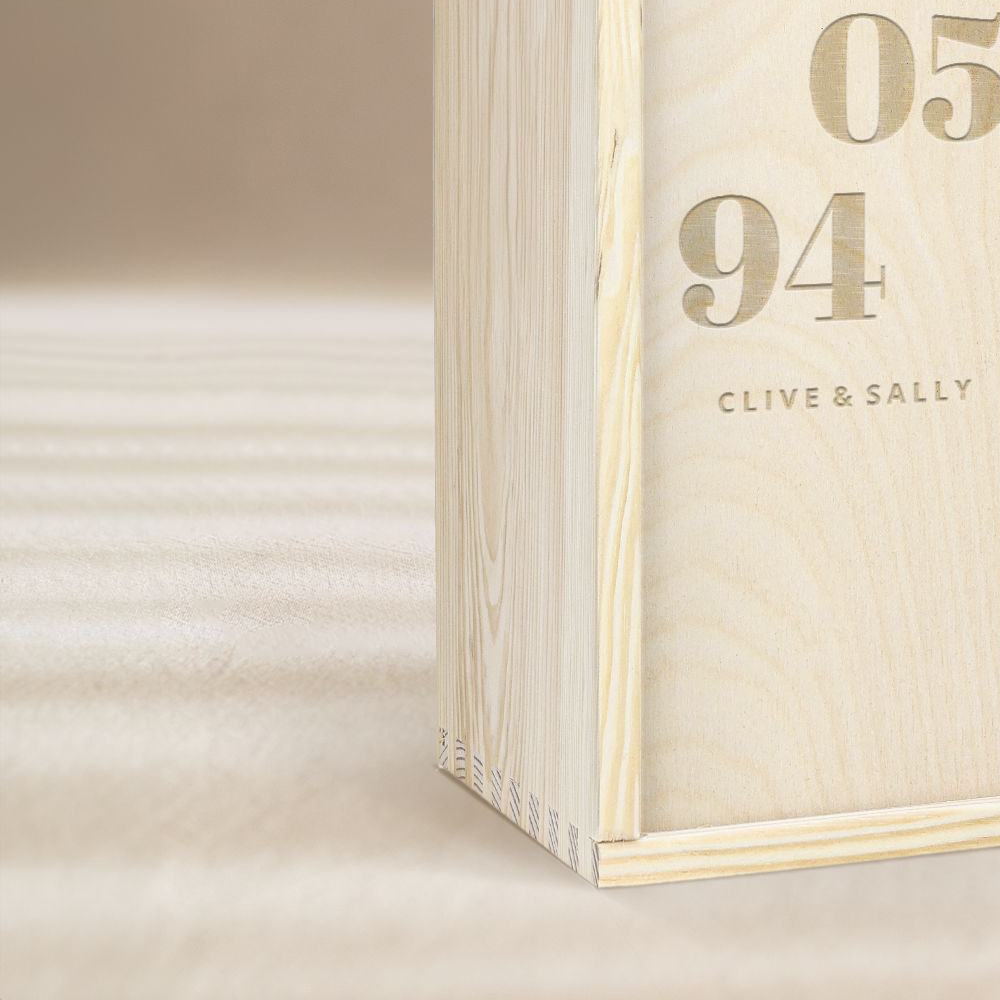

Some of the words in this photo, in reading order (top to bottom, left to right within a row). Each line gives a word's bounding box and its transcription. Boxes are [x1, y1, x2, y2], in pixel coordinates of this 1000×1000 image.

[678, 191, 887, 329] 94
[718, 387, 819, 414] CLIVE
[833, 385, 854, 407] &
[866, 378, 972, 406] SALLY
